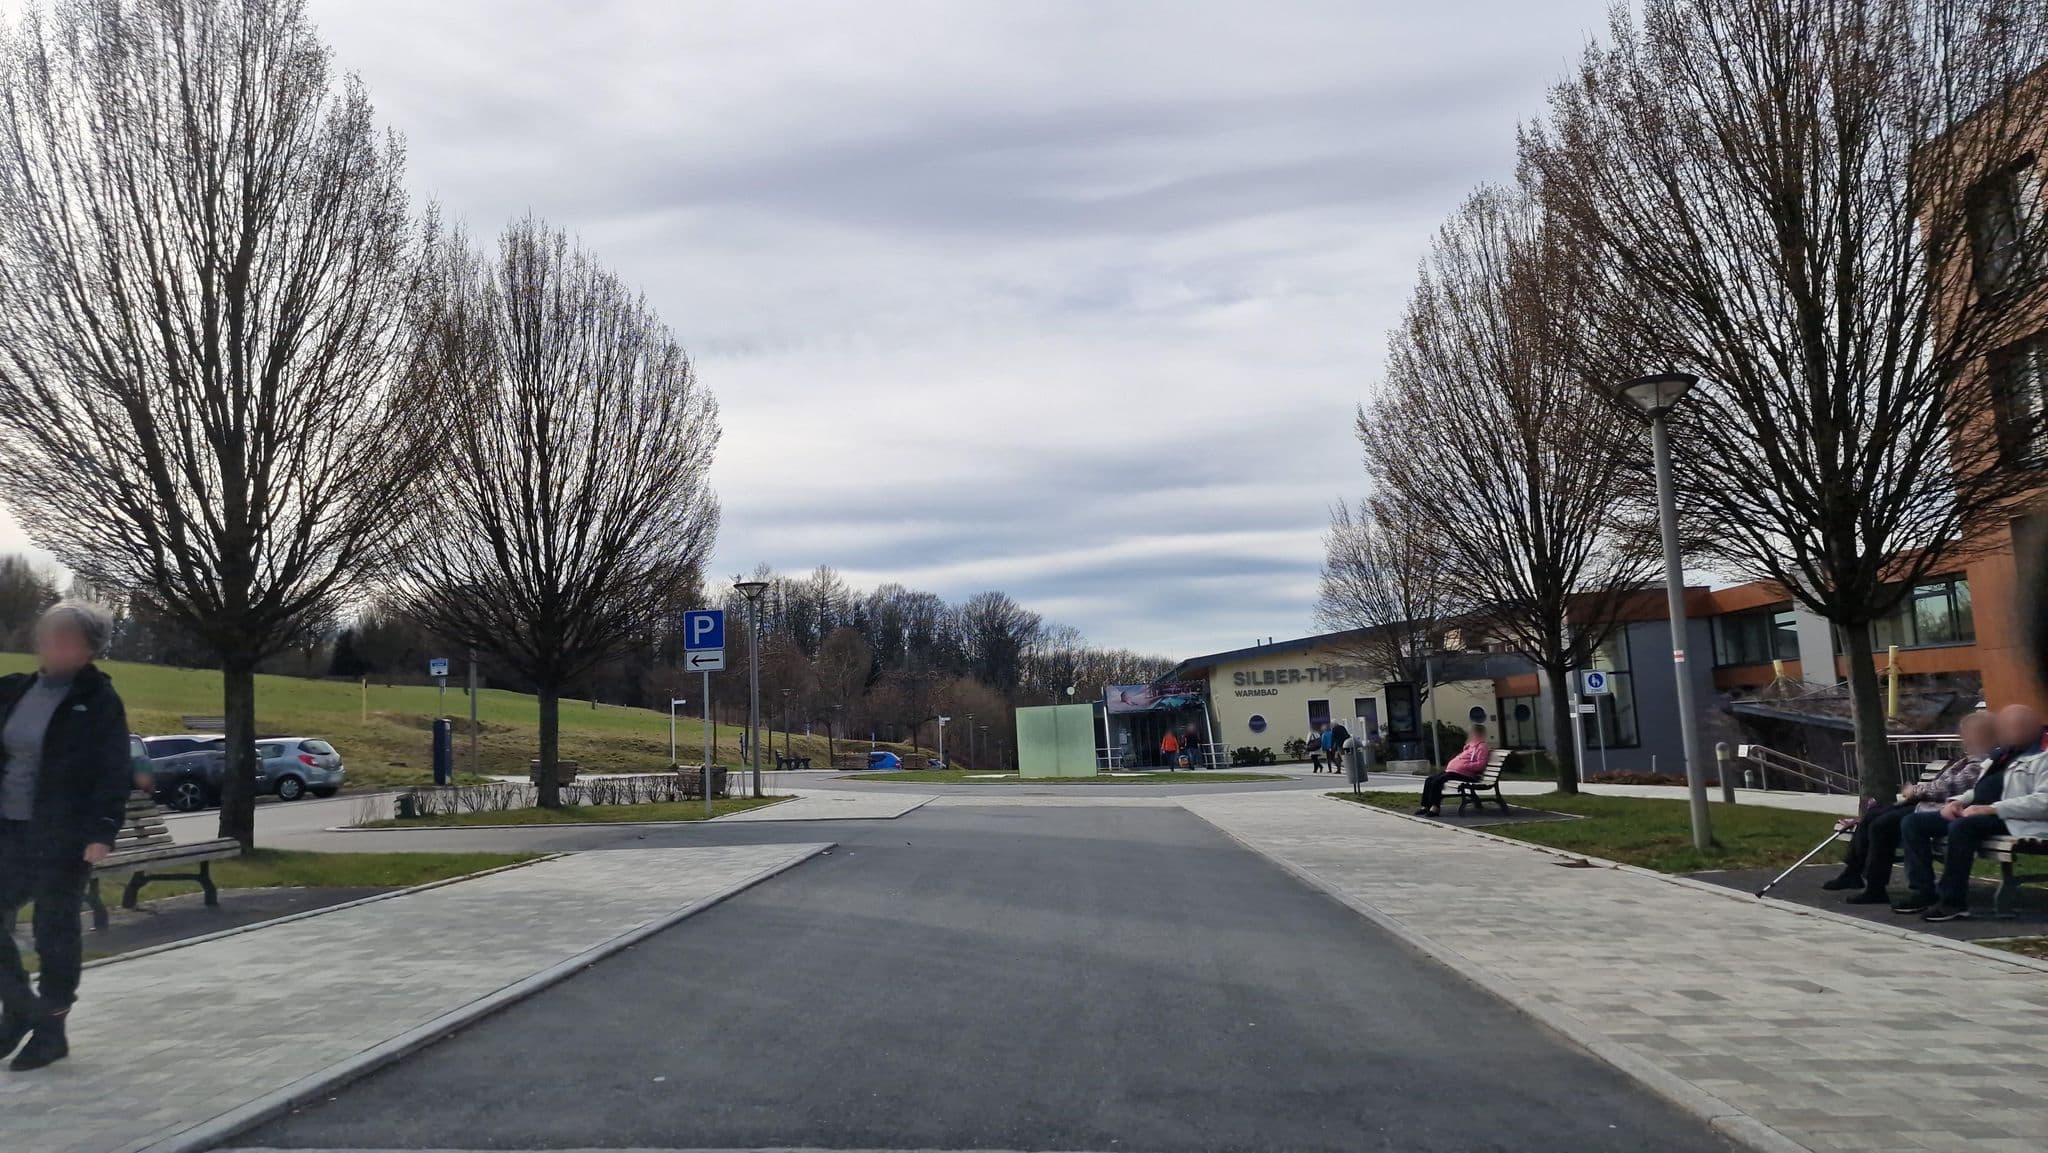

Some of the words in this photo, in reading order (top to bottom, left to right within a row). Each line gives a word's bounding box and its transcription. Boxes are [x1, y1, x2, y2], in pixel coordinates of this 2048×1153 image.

[694, 616, 714, 645] P
[1233, 666, 1383, 686] SILBER-THE
[1234, 689, 1278, 698] WARMBAD
